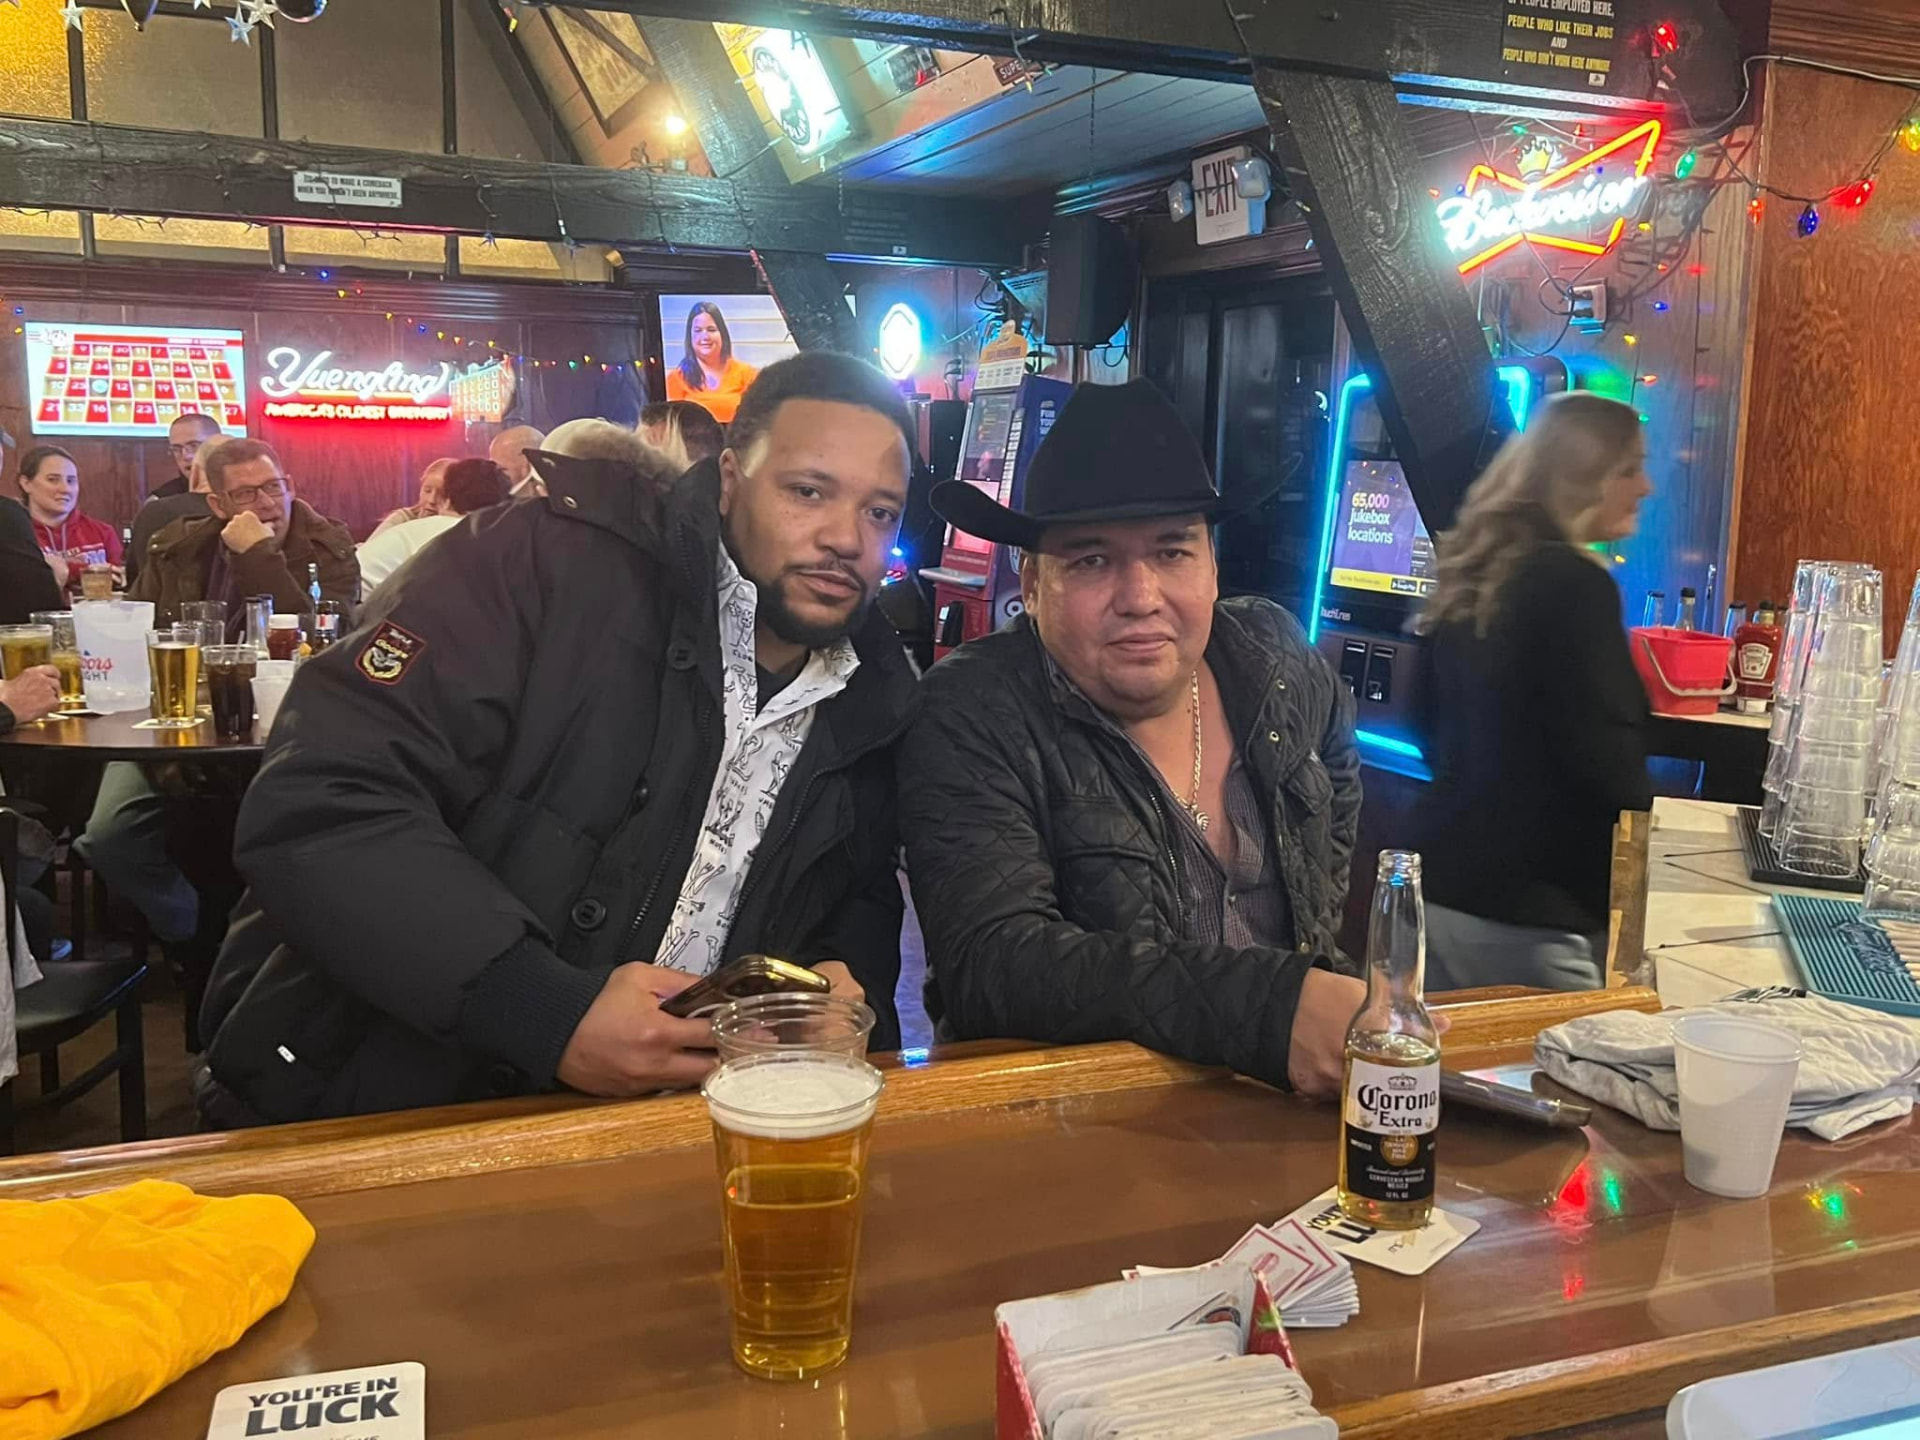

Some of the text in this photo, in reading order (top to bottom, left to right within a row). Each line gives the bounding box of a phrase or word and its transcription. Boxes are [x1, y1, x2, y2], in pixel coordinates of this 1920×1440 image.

[1551, 0, 1591, 14] EMPLOYED
[1507, 14, 1615, 40] PEOPLE WHO LIKE THEIR JOBS
[1550, 36, 1568, 49] AND
[1502, 47, 1523, 62] PEOPLE
[1524, 50, 1537, 64] WHO
[1202, 156, 1238, 218] EXIT
[260, 346, 450, 403] Yuengling
[115, 383, 129, 391] 12
[157, 384, 170, 392] 19
[93, 404, 106, 413] 16
[136, 406, 152, 414] 23
[225, 407, 238, 415] 27
[264, 402, 335, 419] AMERICA'S
[336, 404, 386, 419] OLDEST
[1352, 492, 1390, 509] 65,000
[1348, 508, 1391, 526] jukebox
[1347, 526, 1394, 545] locations
[1357, 1083, 1437, 1115] Corona
[1379, 1111, 1422, 1128] Extra
[248, 1376, 398, 1408] YOU'RE IN
[244, 1390, 401, 1437] LUCK
